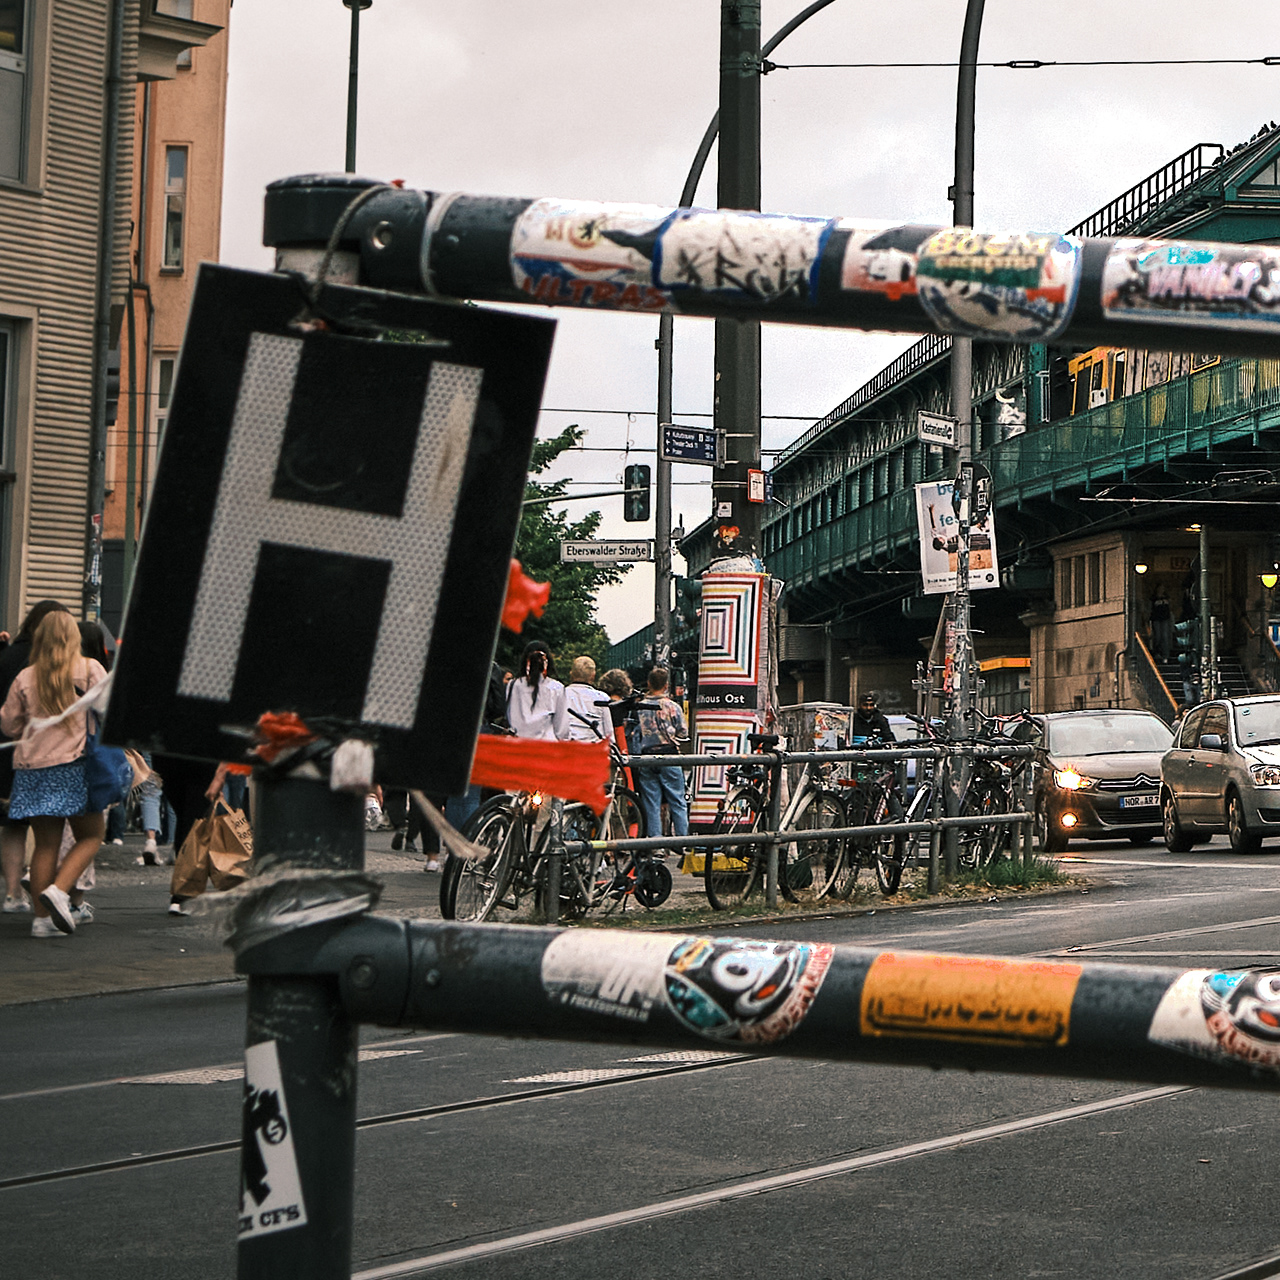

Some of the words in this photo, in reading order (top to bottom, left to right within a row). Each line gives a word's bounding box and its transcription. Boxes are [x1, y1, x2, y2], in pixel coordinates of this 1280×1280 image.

[176, 332, 484, 730] H
[566, 545, 617, 556] Eberswalder
[620, 545, 646, 557] Straße
[725, 694, 745, 704] Ost
